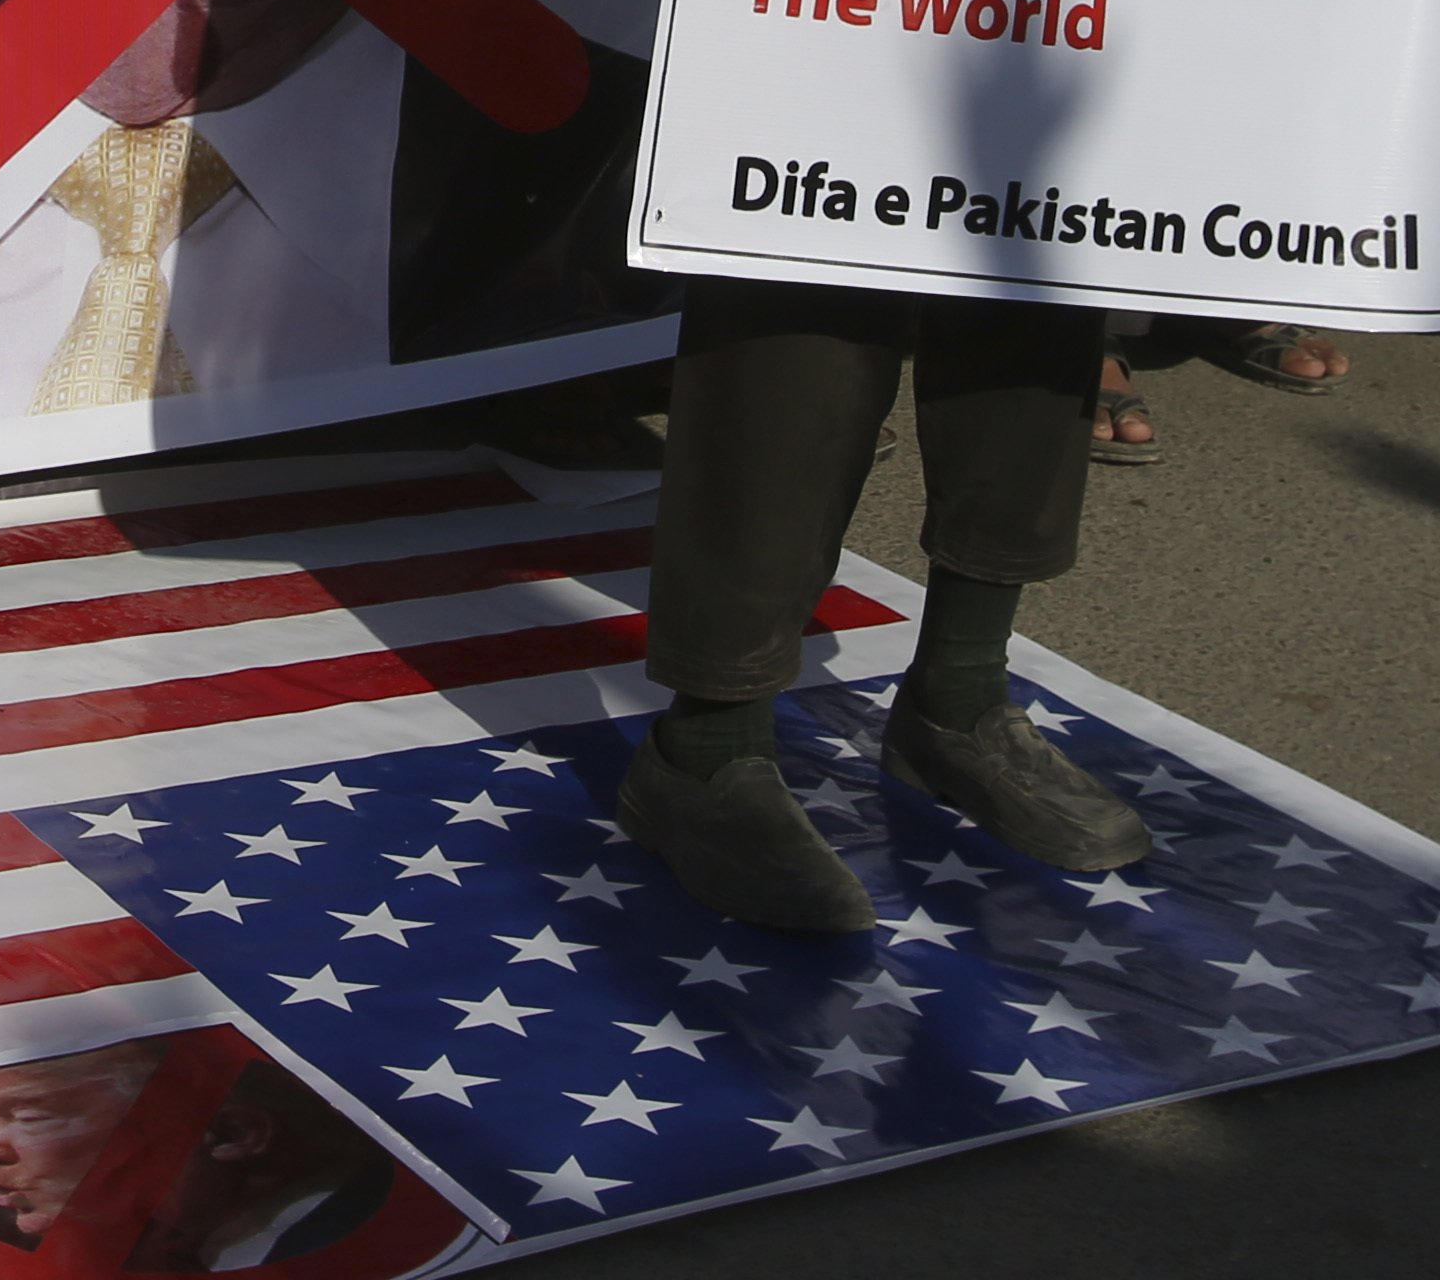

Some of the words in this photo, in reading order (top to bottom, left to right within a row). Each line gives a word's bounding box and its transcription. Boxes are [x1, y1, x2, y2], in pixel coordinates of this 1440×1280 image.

[732, 157, 857, 222] Difa
[875, 185, 910, 226] e
[927, 176, 1186, 254] Pakistan
[1203, 205, 1418, 270] Council
